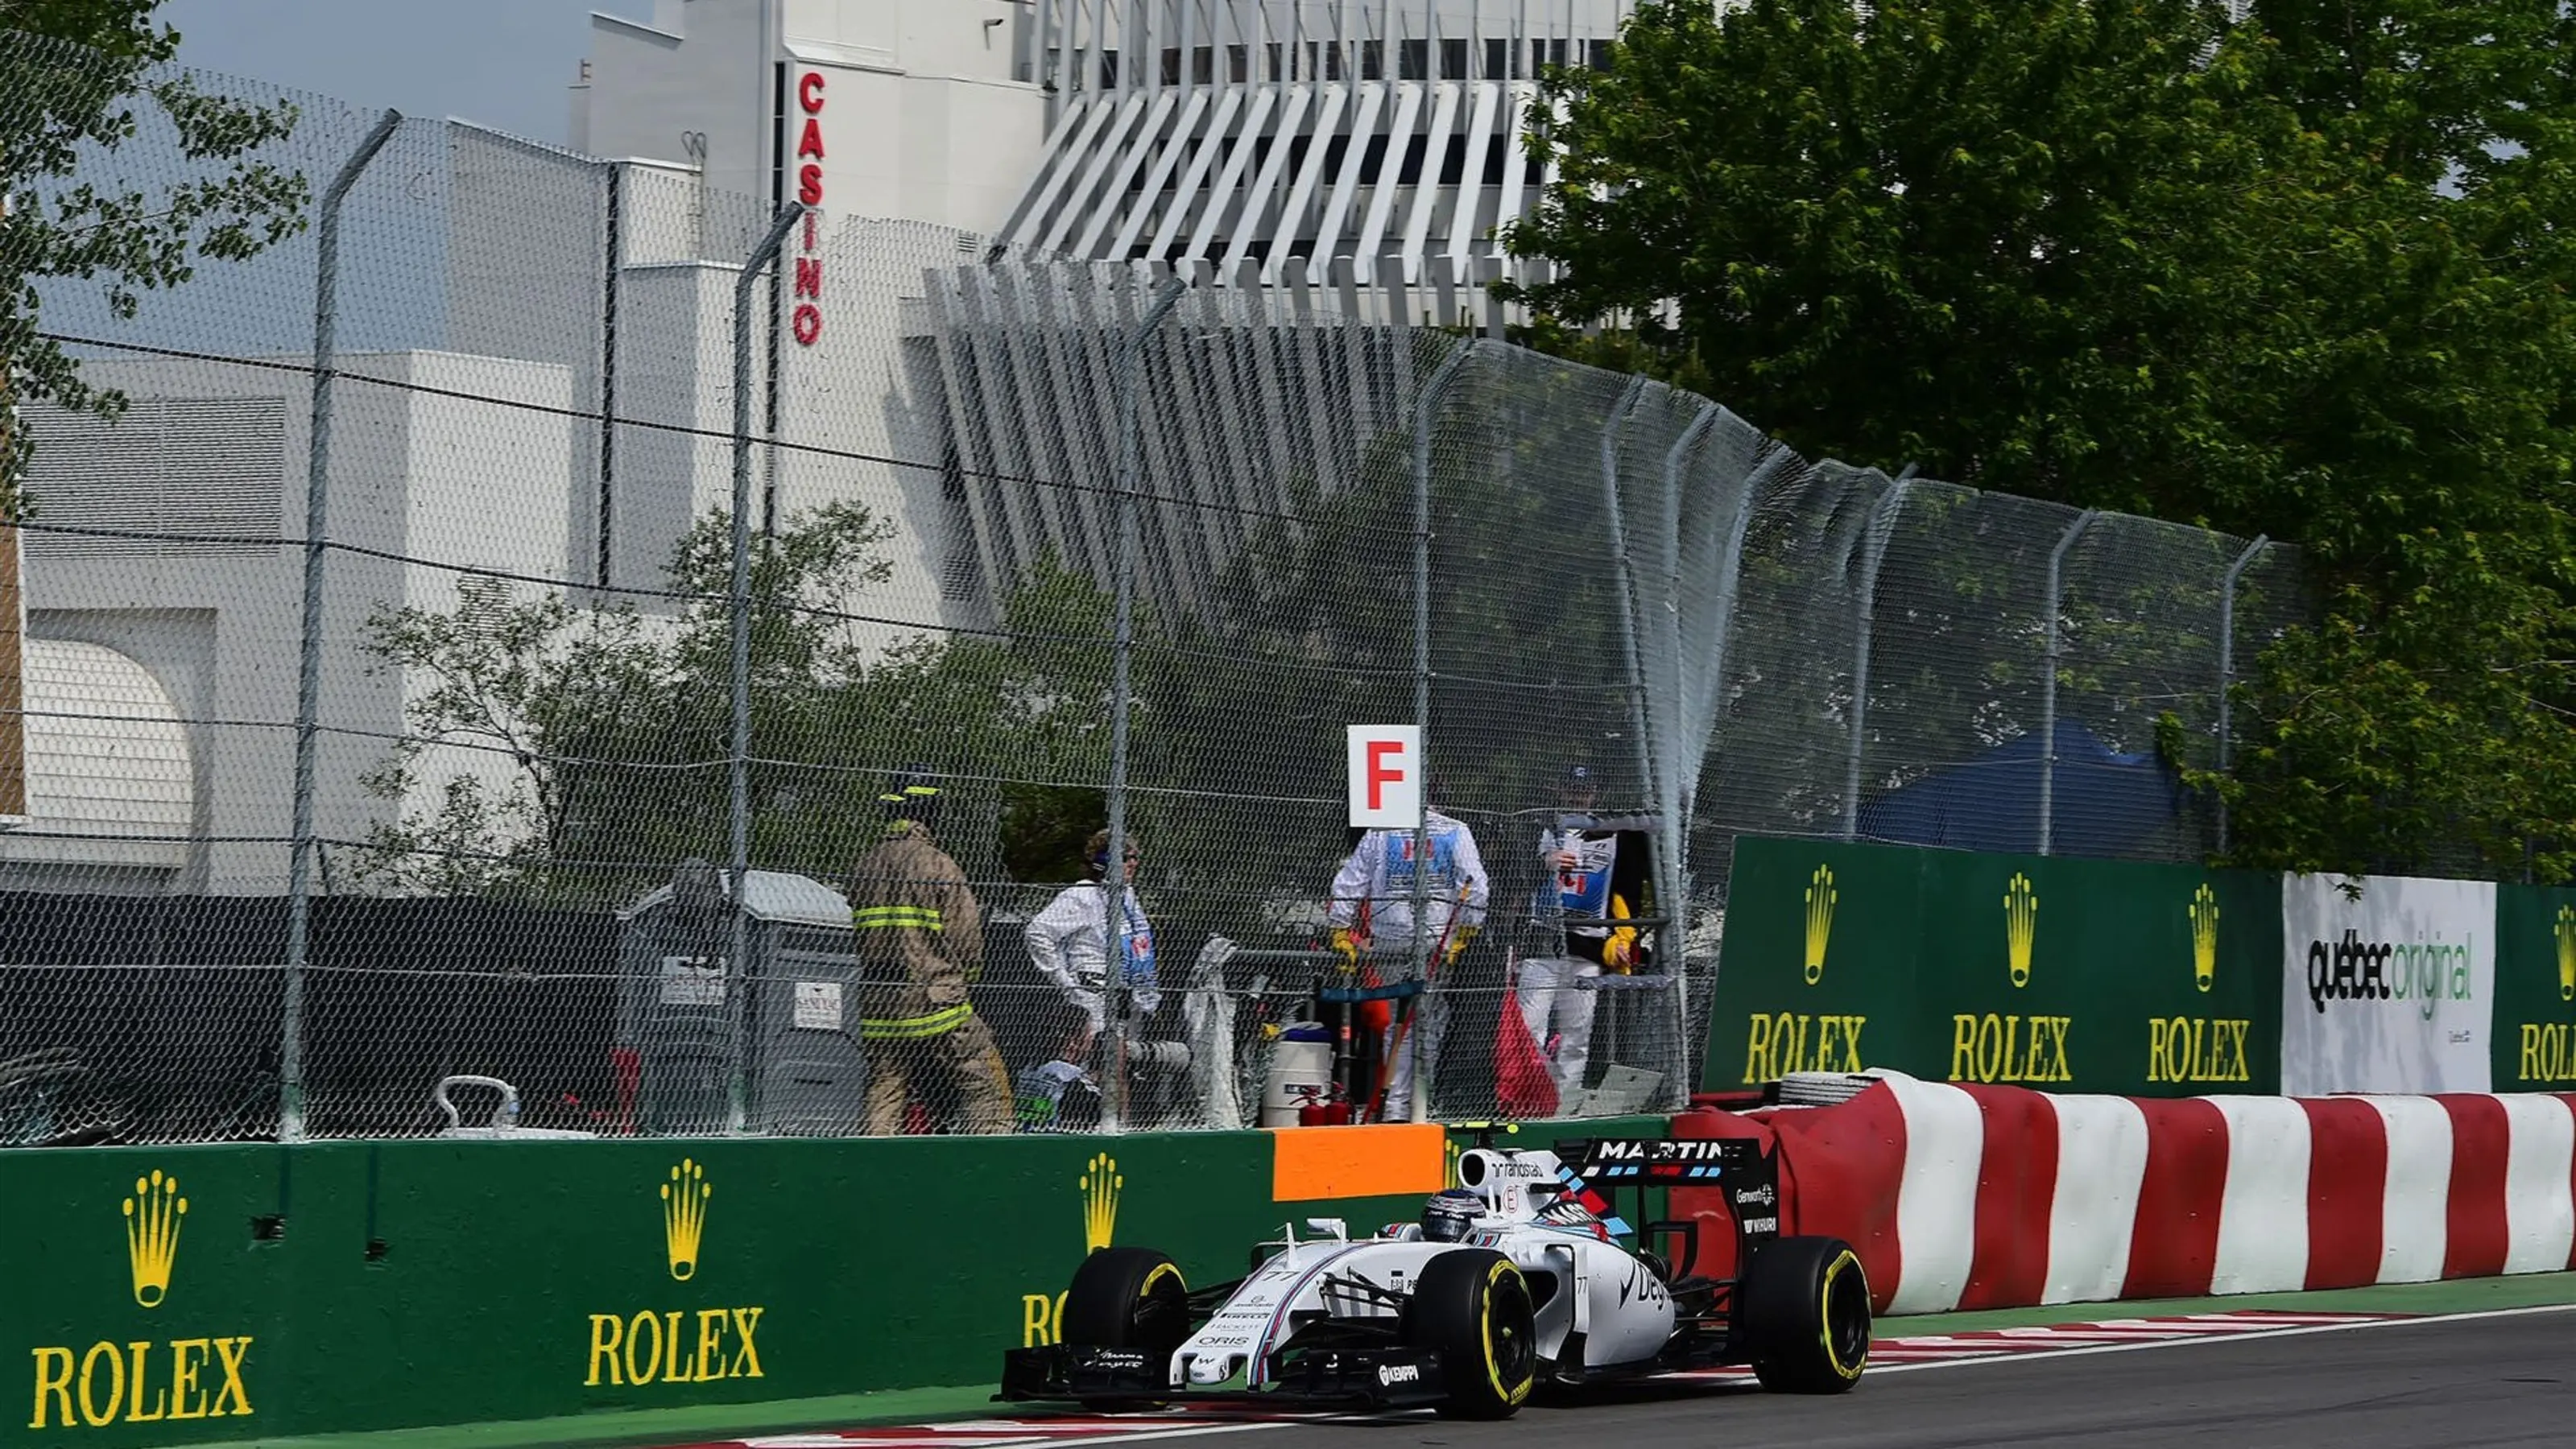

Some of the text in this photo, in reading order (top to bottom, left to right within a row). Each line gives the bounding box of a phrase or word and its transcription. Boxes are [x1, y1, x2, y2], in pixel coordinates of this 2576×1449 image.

[793, 72, 825, 345] CASINO
[1367, 741, 1404, 809] F
[1743, 1013, 1866, 1084] ROLEX
[1949, 1013, 2072, 1082] ROLEX
[2147, 1017, 2250, 1083] ROLEX
[1263, 1271, 1300, 1282] 77
[1577, 1276, 1588, 1294] 77
[585, 1307, 764, 1386] ROLEX
[1199, 1336, 1249, 1345] ORIS
[1387, 1365, 1419, 1382] KEMPPI
[28, 1336, 254, 1429] ROLEX
